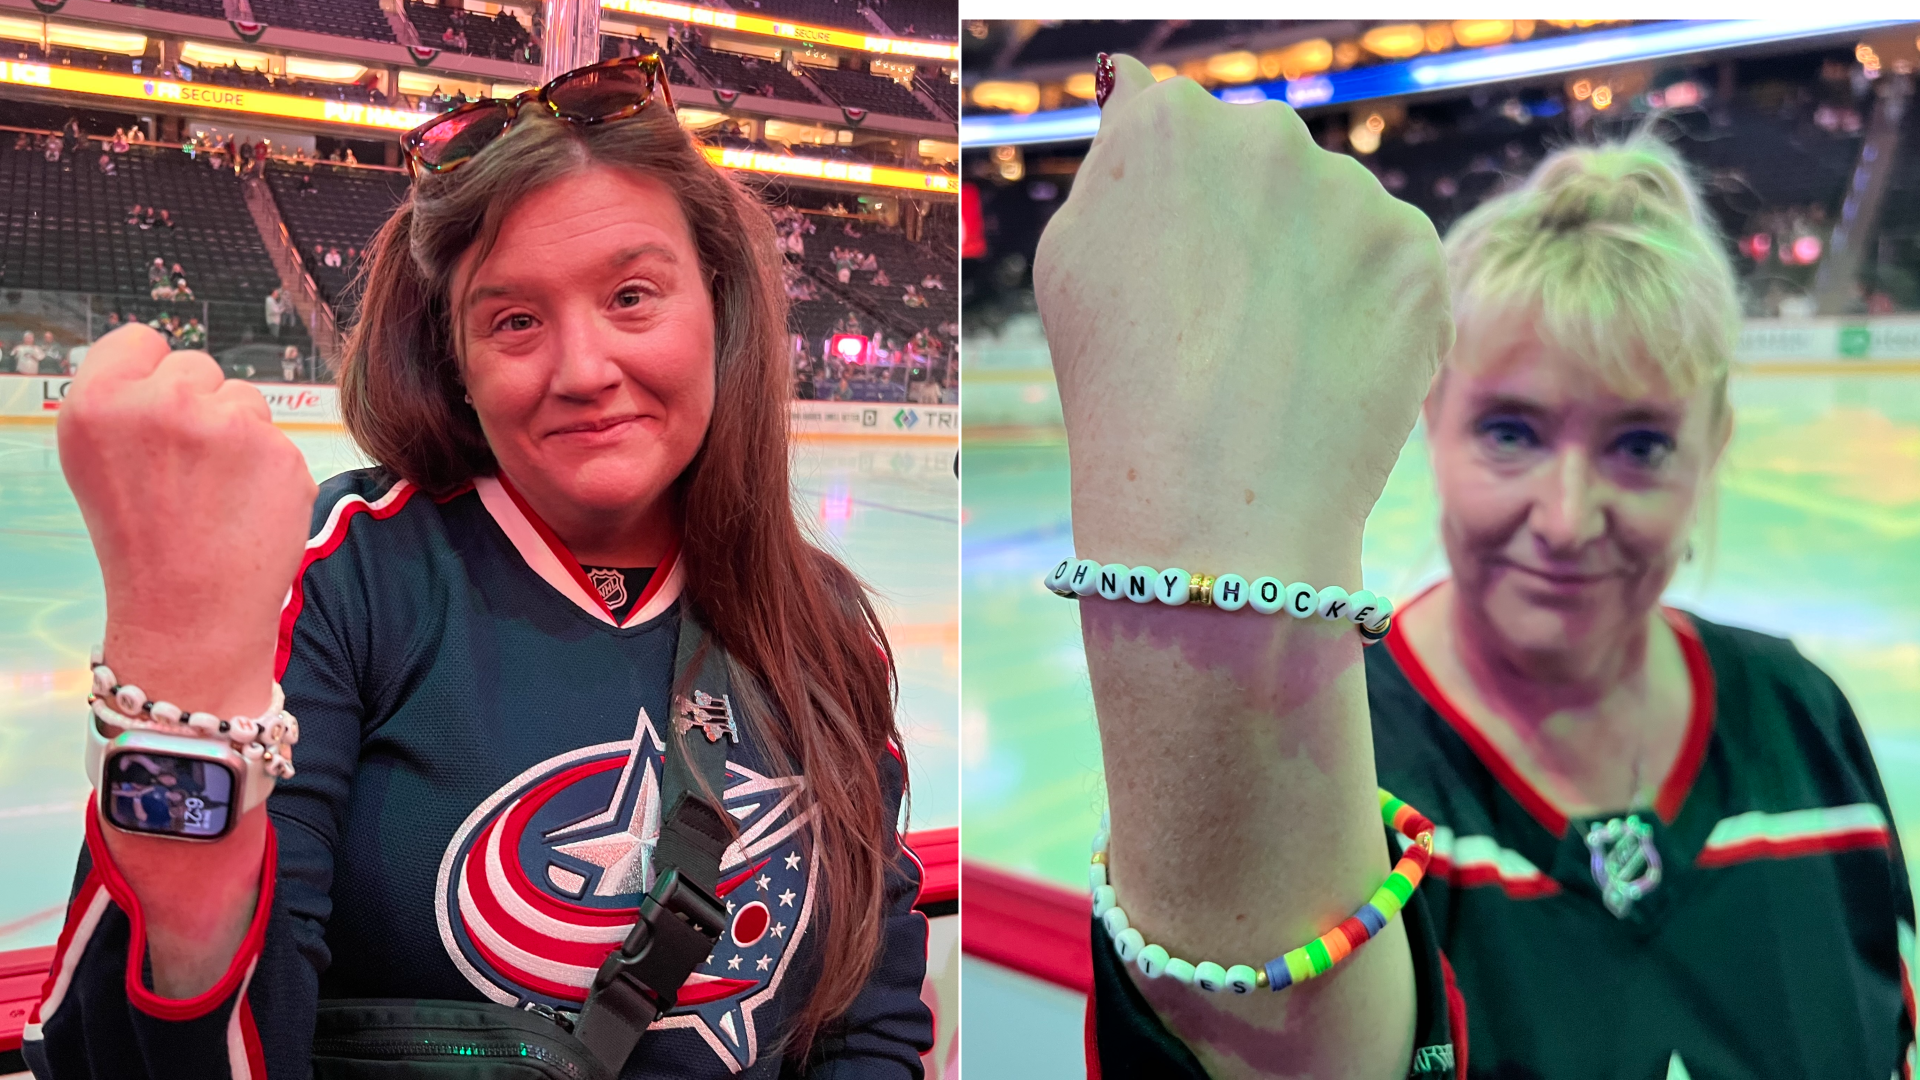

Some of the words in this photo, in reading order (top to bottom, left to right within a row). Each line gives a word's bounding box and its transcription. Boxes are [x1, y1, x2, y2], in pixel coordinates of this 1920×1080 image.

[12, 62, 51, 85] ICE
[325, 101, 364, 122] PUT
[723, 149, 753, 168] PUT
[849, 165, 872, 182] ICE
[183, 797, 205, 828] 6:21
